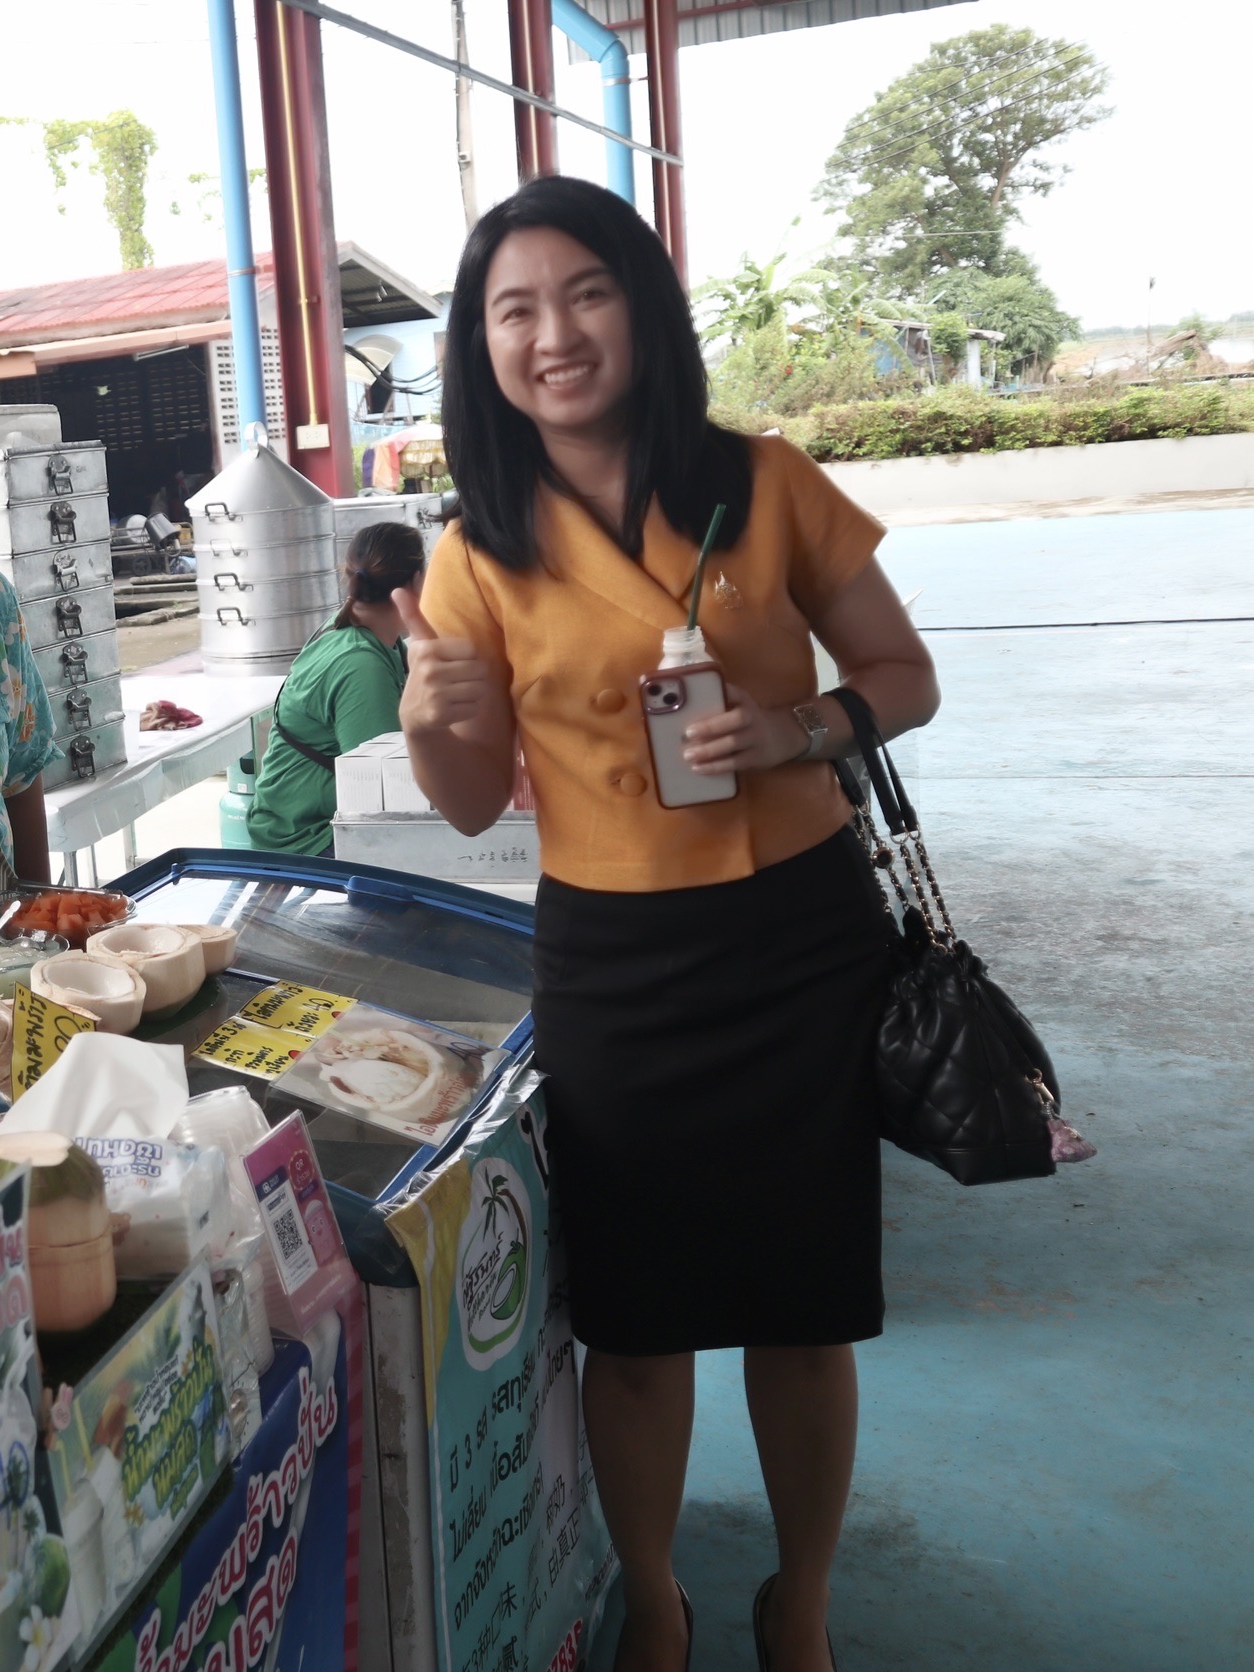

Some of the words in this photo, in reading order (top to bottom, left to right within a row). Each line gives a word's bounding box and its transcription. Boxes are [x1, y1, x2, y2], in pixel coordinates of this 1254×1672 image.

[222, 1026, 238, 1036] 3
[224, 1048, 245, 1063] กะทิ
[450, 1444, 459, 1494] มี
[464, 1433, 473, 1471] 3
